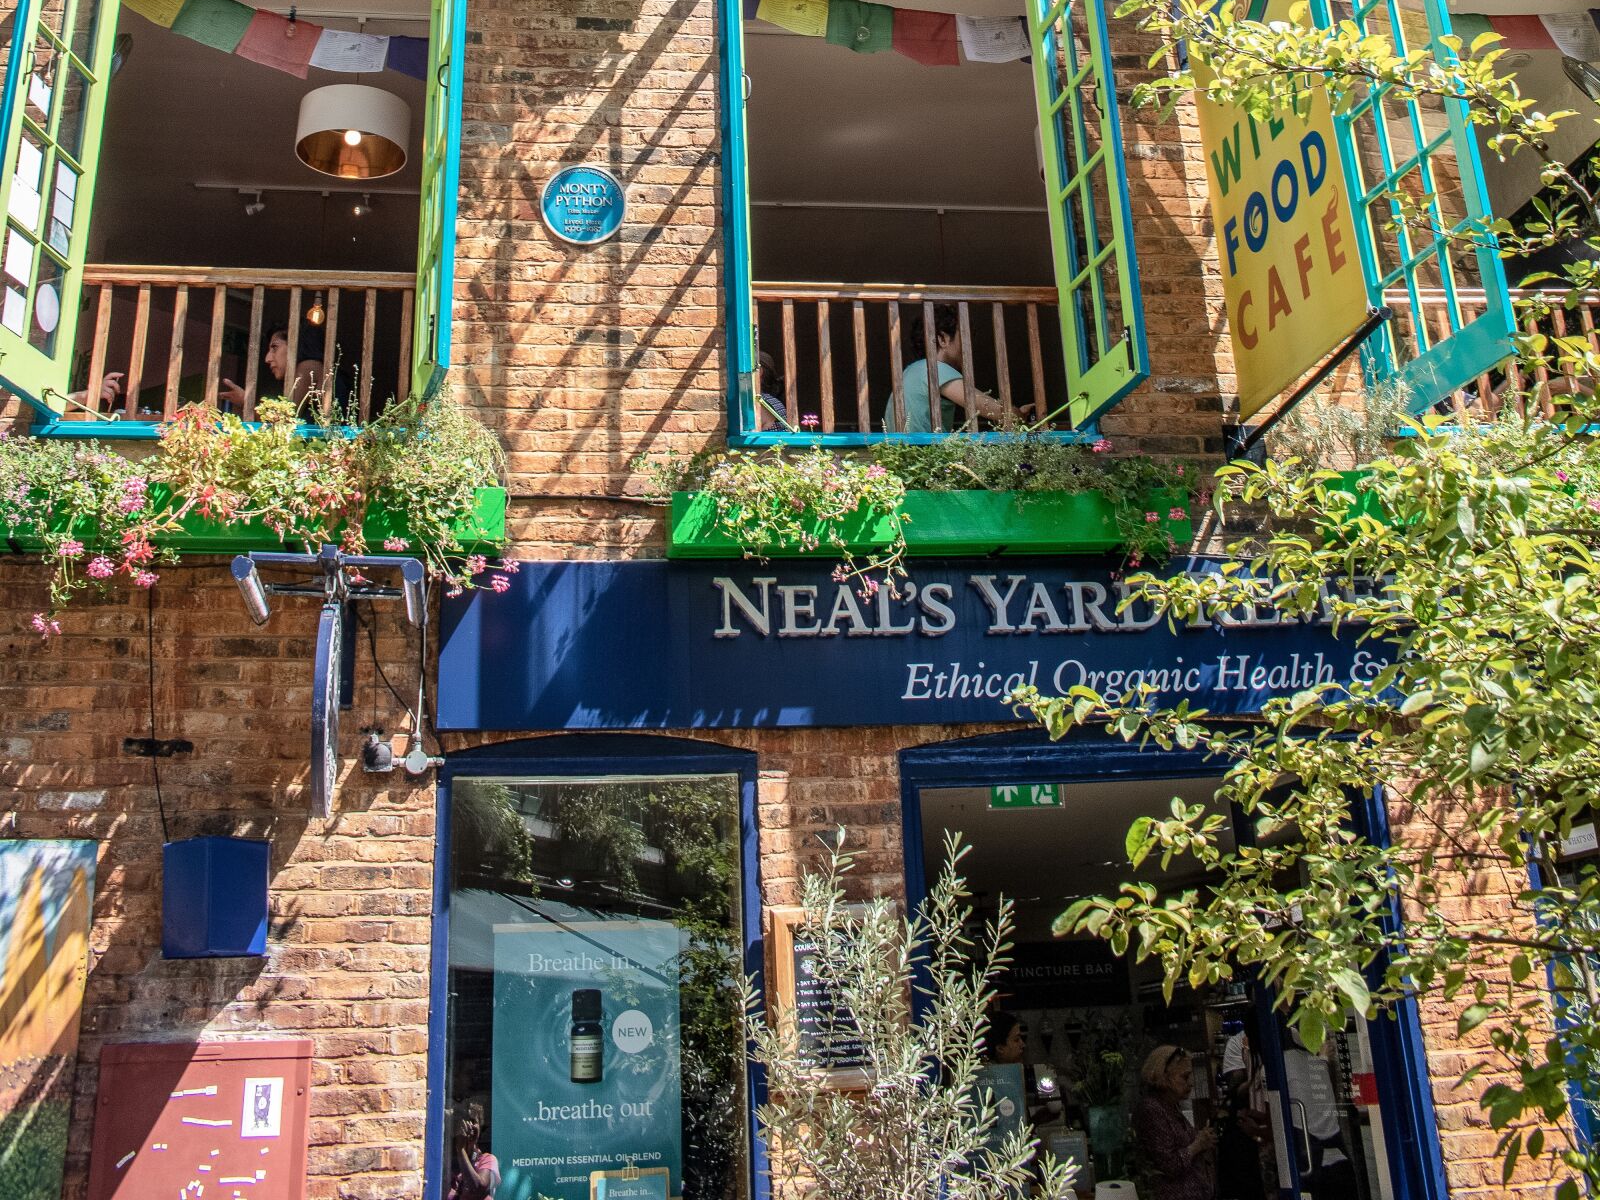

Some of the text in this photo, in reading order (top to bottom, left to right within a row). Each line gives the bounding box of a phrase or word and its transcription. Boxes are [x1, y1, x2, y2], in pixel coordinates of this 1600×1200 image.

[560, 183, 608, 194] MONTY
[555, 195, 613, 207] PYTHON
[1224, 131, 1326, 277] FOOD
[713, 576, 956, 638] NEAL'S
[969, 574, 1166, 634] YARD
[901, 661, 1038, 700] Ethical
[1054, 657, 1200, 703] Organic
[1213, 651, 1335, 692] Health
[528, 951, 646, 972] Breathe in...
[1011, 963, 1113, 977] TINCTURE BAR
[618, 1027, 647, 1038] NEW
[522, 1099, 653, 1121] ...breathe out
[512, 1156, 565, 1167] MEDITATION
[566, 1153, 613, 1165] ESSENTIAL
[633, 1151, 662, 1161] BLEND
[609, 1188, 638, 1197] Breathe
